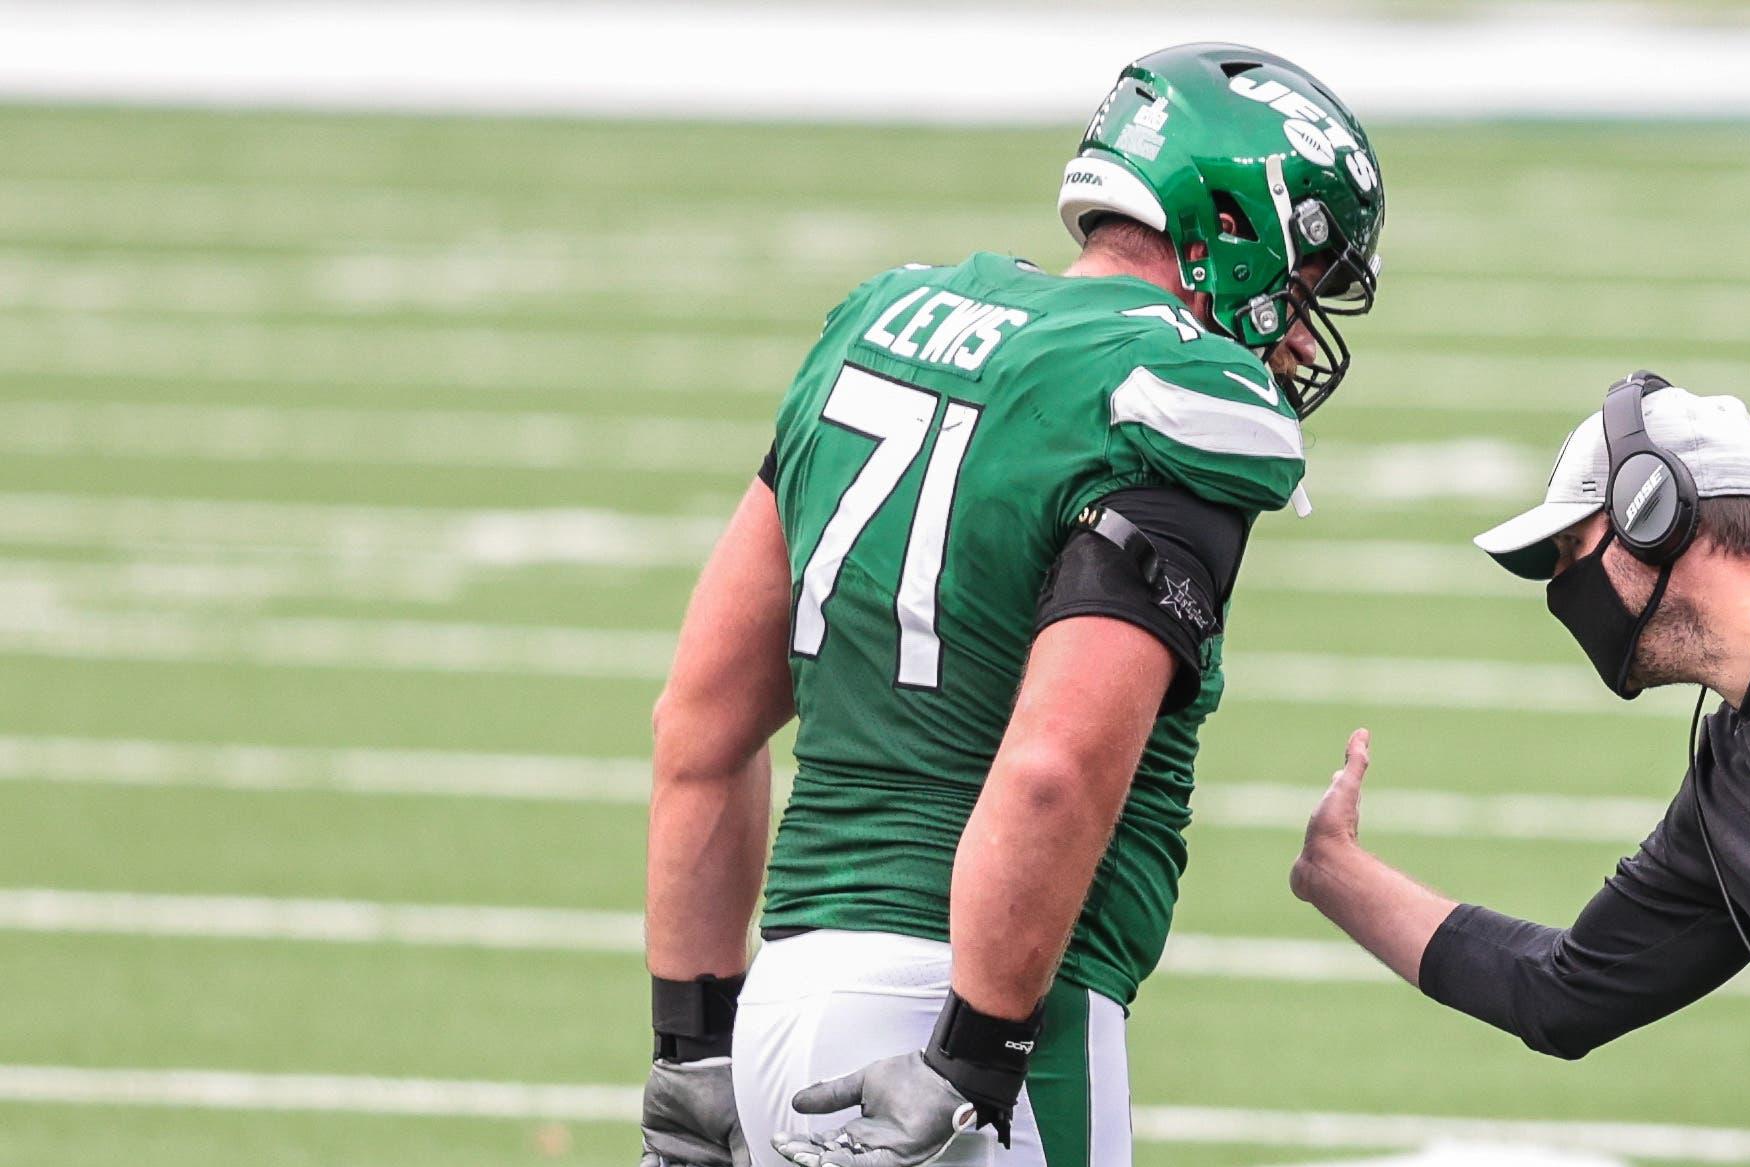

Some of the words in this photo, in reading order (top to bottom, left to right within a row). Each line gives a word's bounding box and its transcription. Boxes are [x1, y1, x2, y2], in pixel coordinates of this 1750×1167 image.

[1230, 76, 1378, 192] JETS
[863, 286, 1029, 372] LEWIS
[792, 359, 986, 690] 71
[1624, 464, 1664, 532] BOSE
